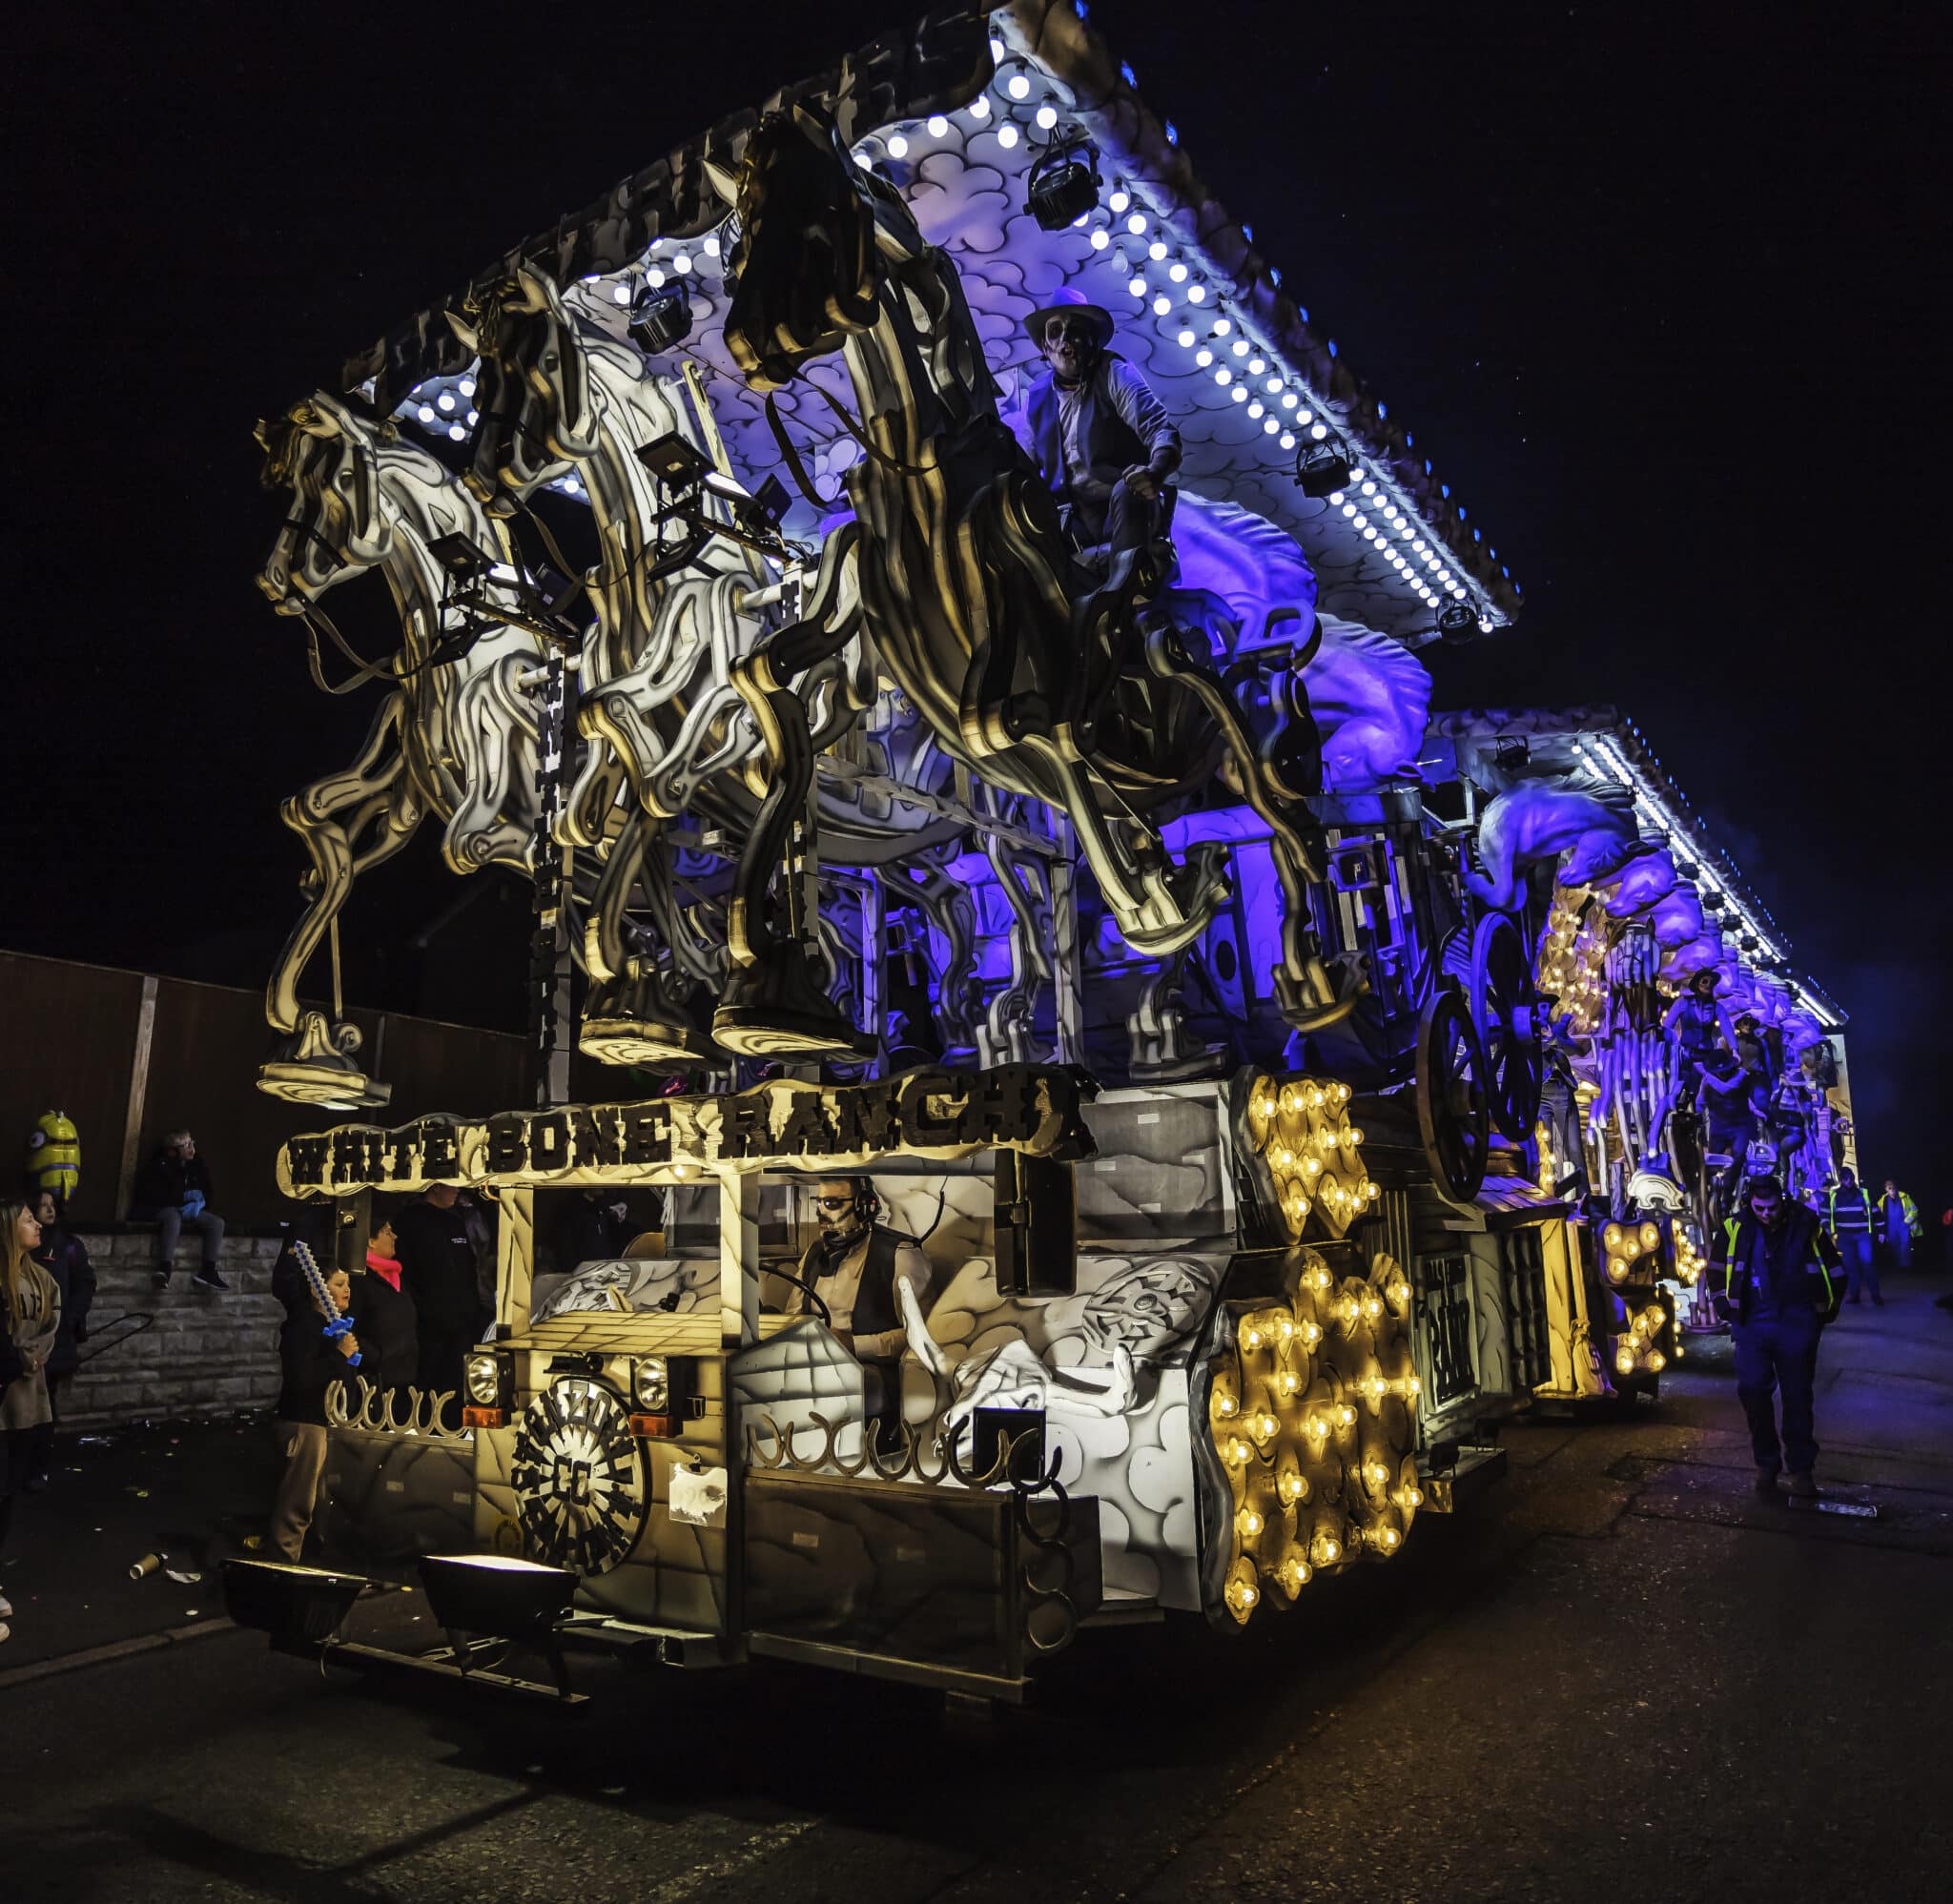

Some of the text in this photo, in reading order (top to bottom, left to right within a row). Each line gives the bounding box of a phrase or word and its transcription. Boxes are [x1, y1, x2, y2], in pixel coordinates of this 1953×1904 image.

[288, 1069, 1039, 1185] WHITE BONE RANCH
[553, 1455, 591, 1507] CC
